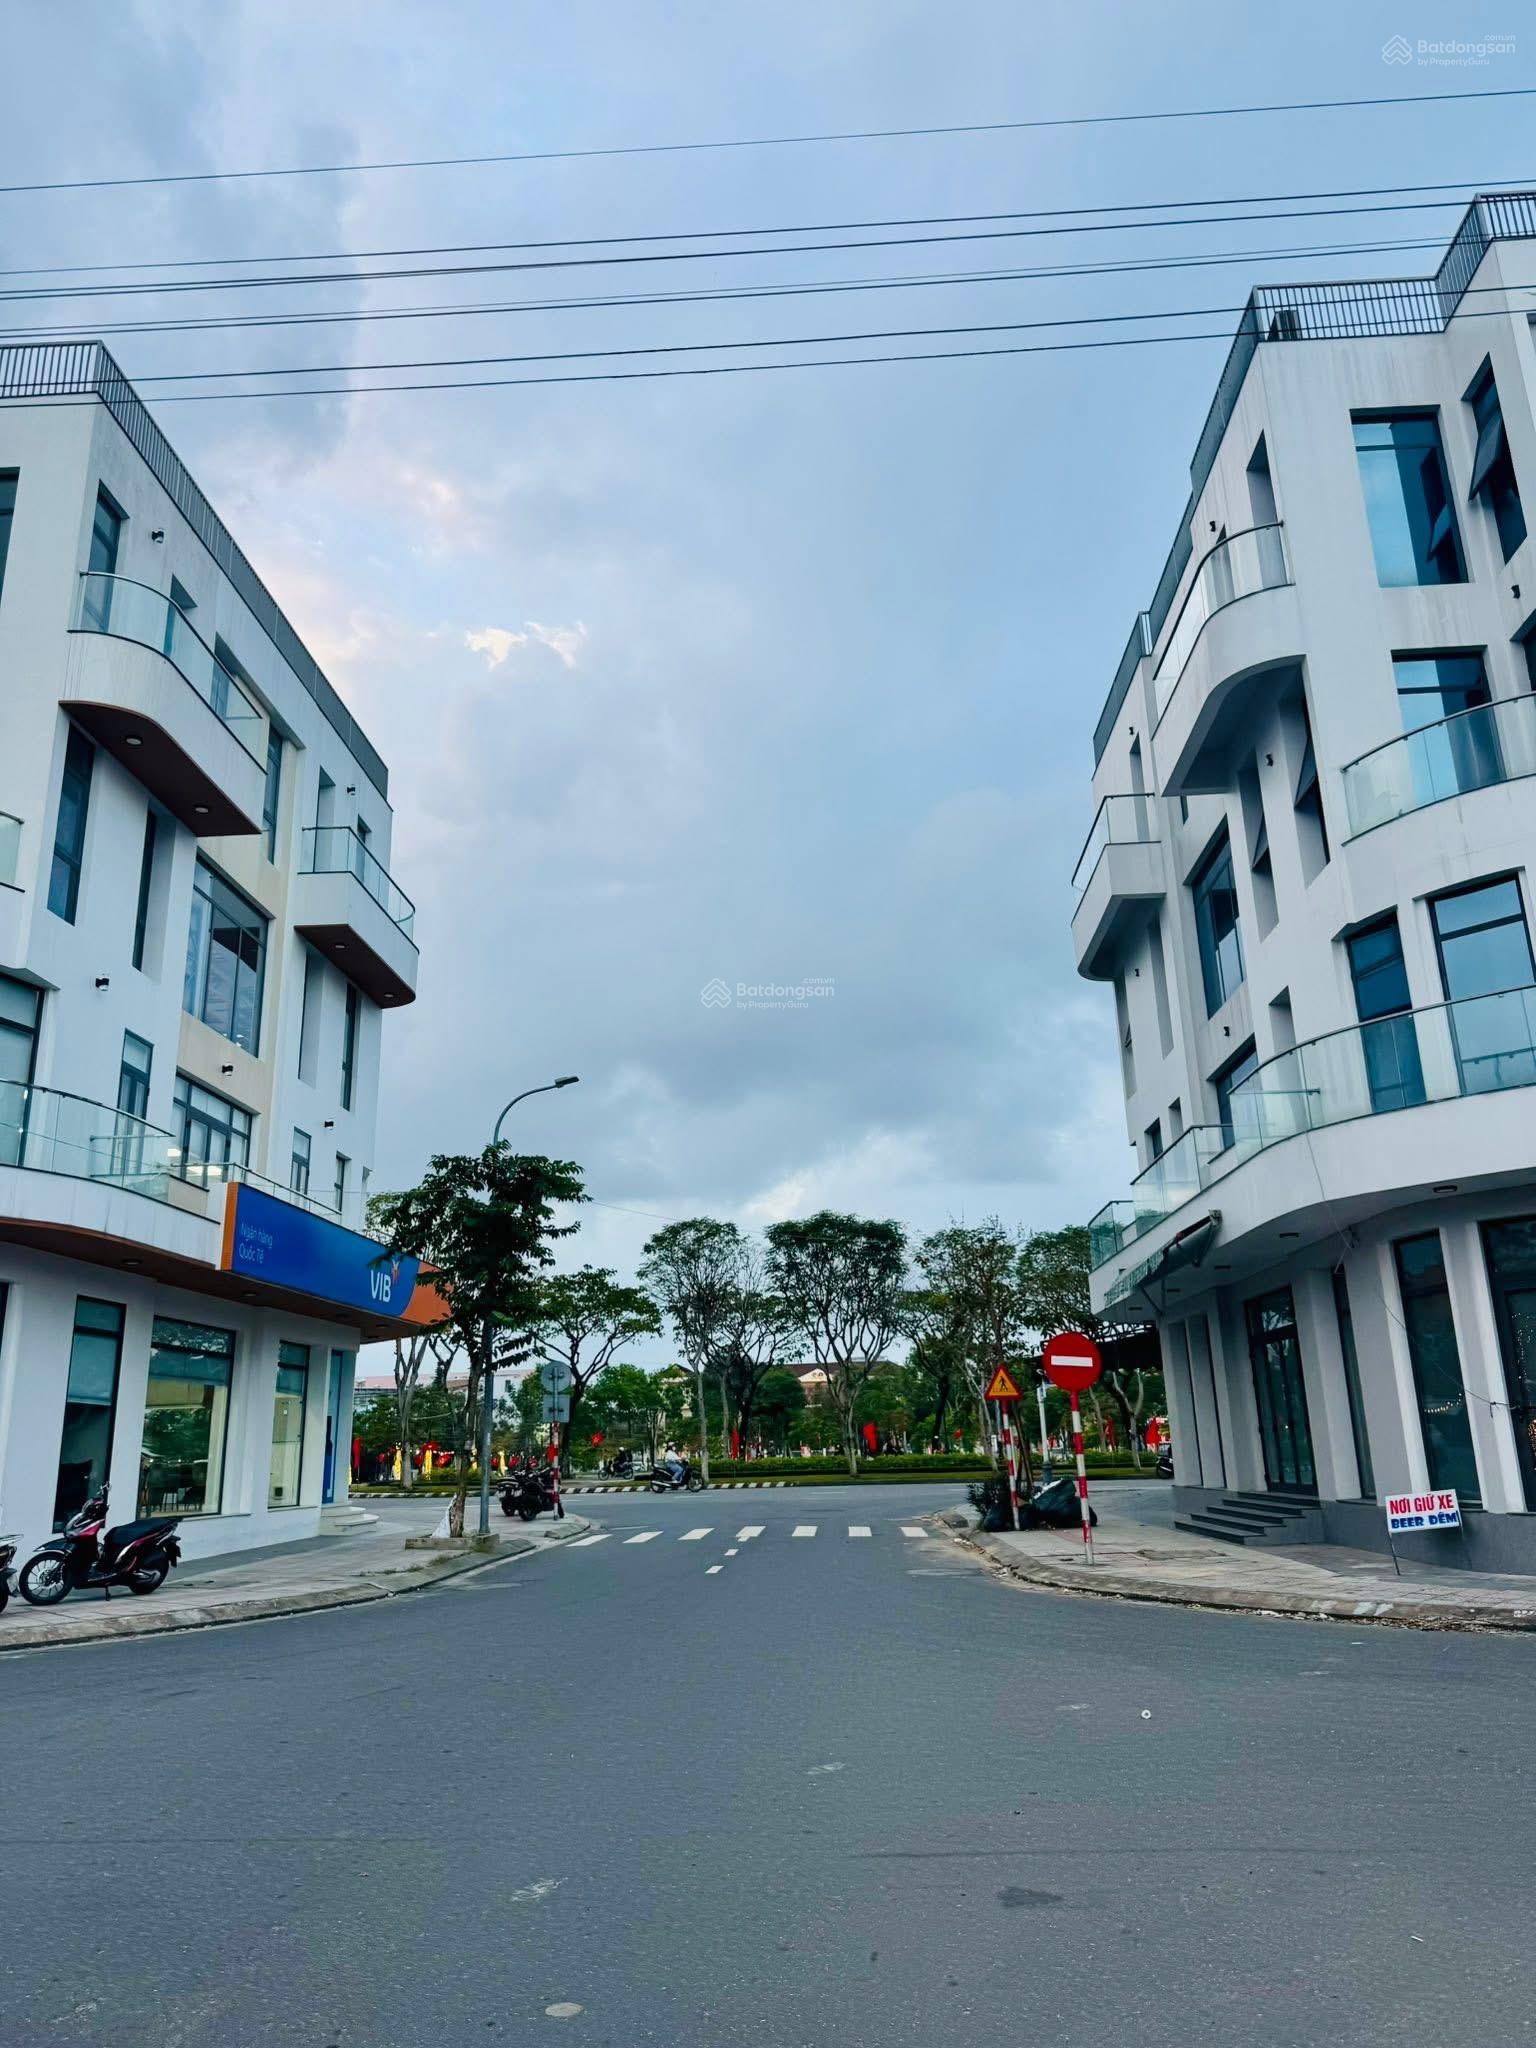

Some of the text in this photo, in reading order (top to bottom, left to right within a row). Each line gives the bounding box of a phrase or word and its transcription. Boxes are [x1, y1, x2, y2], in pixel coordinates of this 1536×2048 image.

[370, 1269, 392, 1303] VIB
[1389, 1493, 1454, 1514] NƠI GIỮ XE
[1391, 1516, 1424, 1529] BEER
